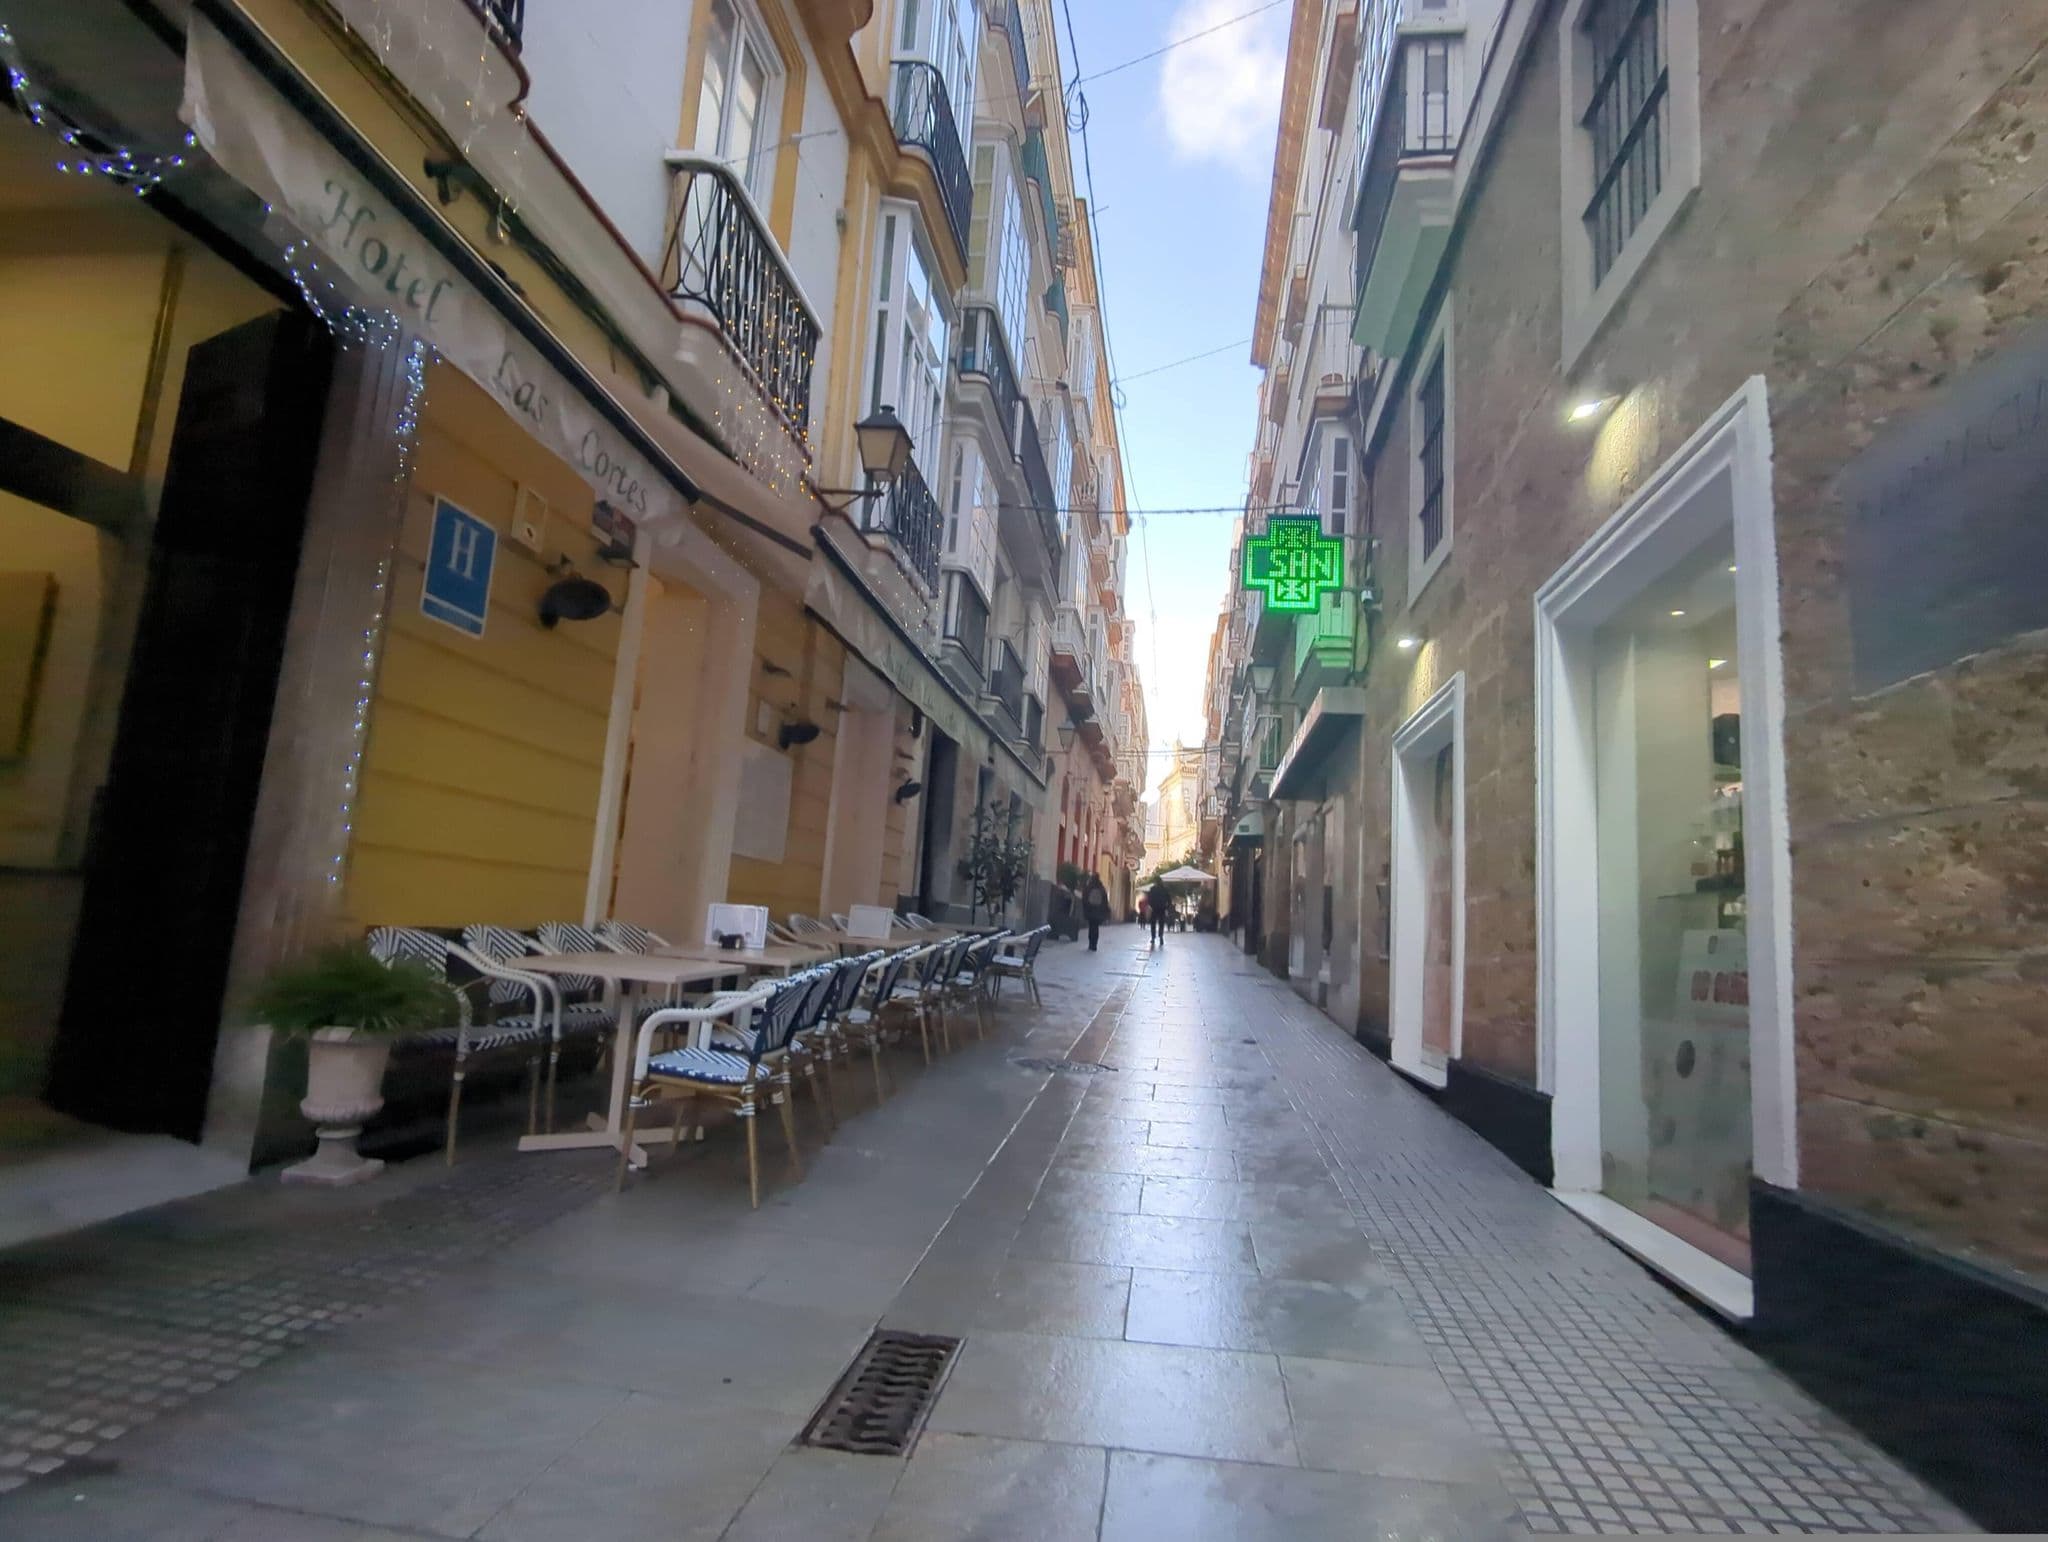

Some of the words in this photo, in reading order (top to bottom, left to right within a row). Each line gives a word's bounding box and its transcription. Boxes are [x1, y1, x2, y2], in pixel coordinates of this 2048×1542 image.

[316, 180, 453, 322] Hotel
[493, 352, 548, 422] Las
[581, 430, 648, 513] Cortes
[447, 518, 480, 580] H
